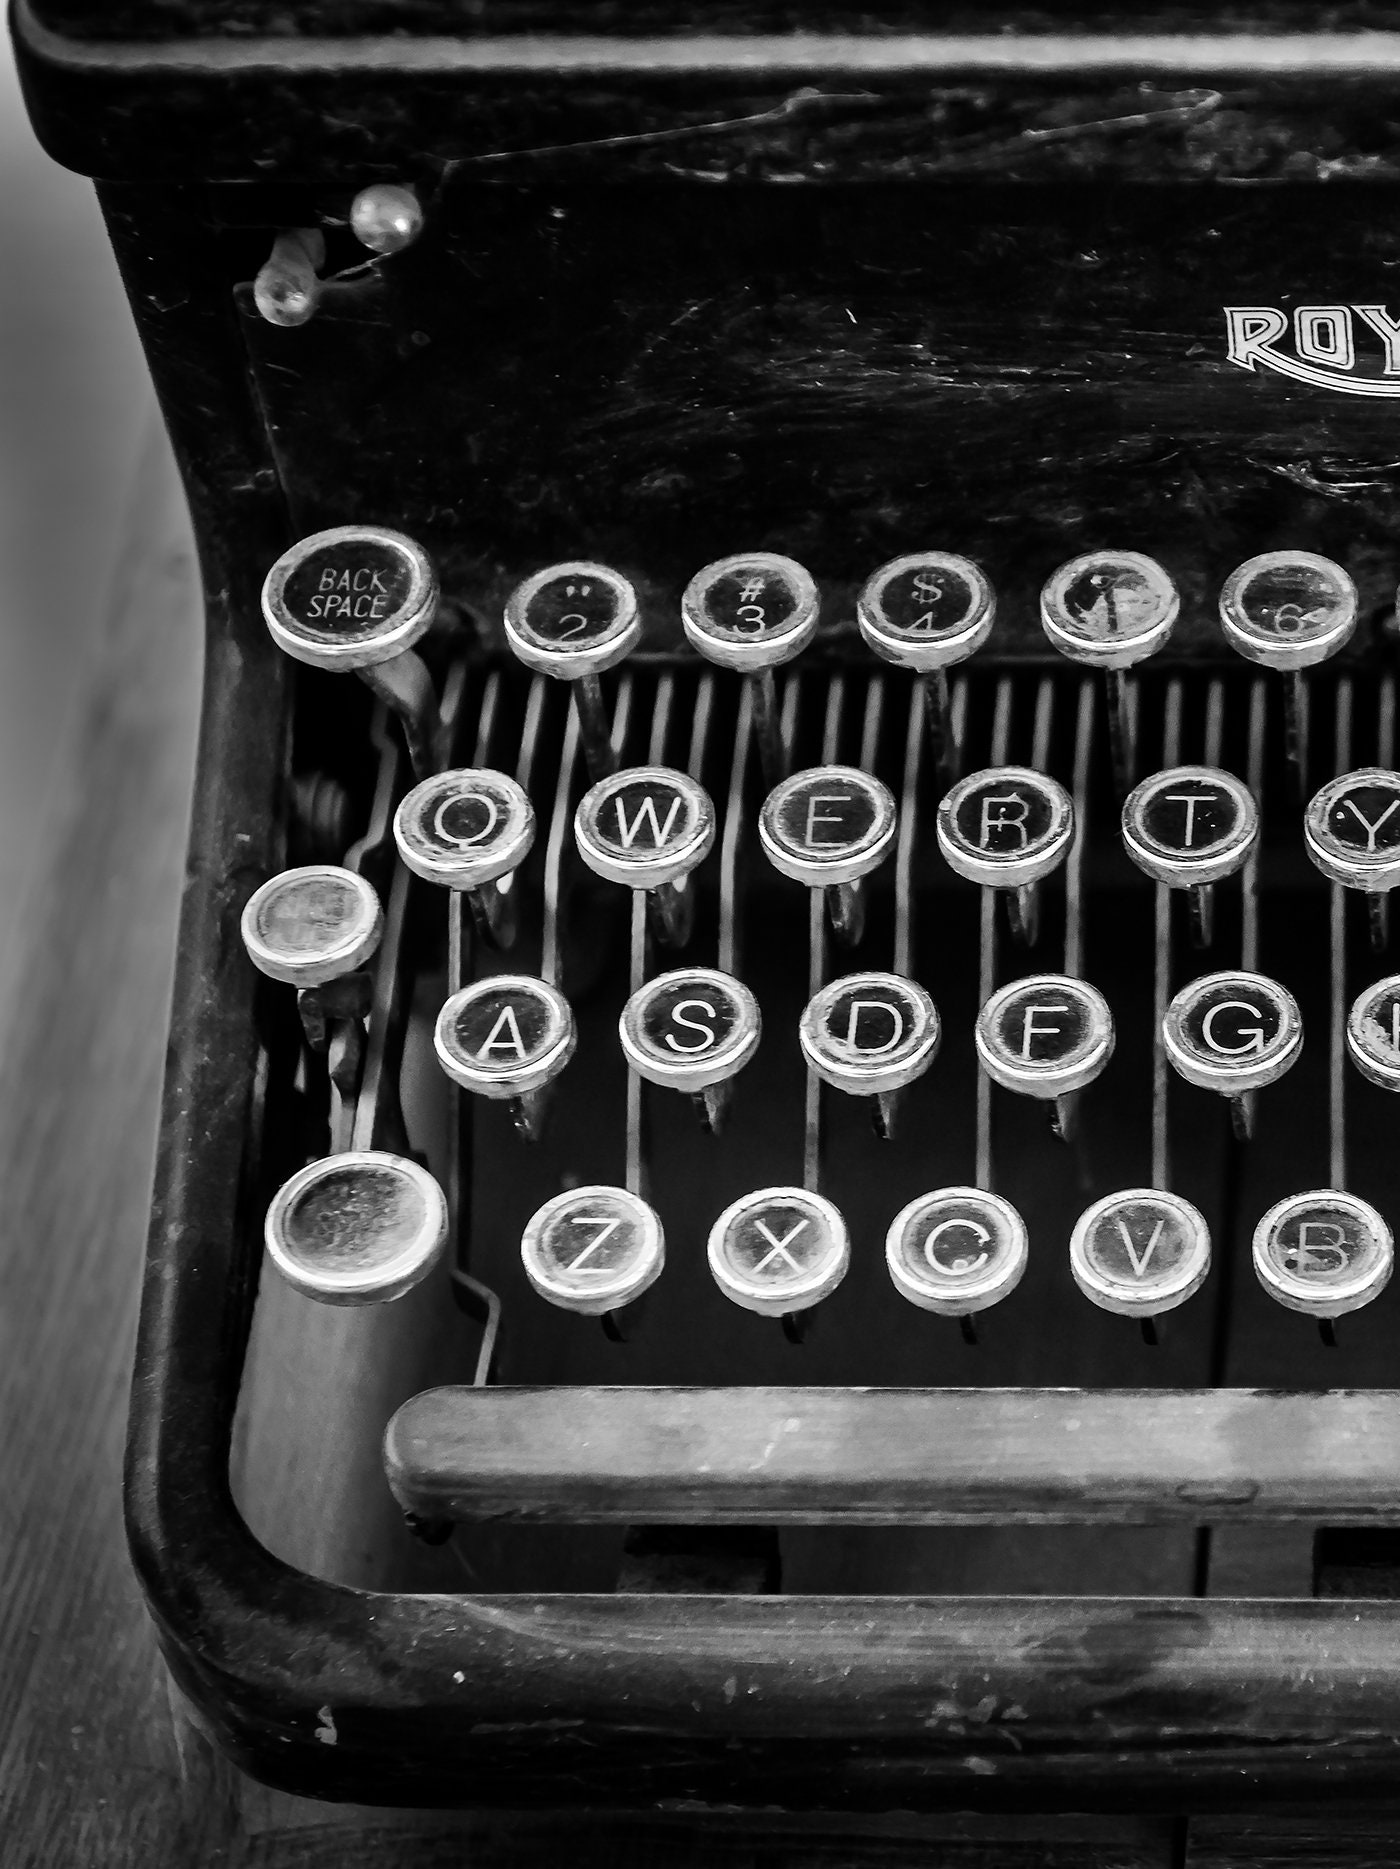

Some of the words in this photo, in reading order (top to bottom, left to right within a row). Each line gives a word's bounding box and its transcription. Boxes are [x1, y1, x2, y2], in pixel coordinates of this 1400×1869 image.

[307, 594, 389, 618] SPACE
[319, 567, 388, 593] BACK
[557, 614, 588, 641] 2
[732, 604, 766, 634] 3
[1273, 603, 1305, 634] 6
[615, 796, 682, 848] W
[805, 795, 852, 847] E
[980, 796, 1030, 848] R
[1165, 796, 1218, 847] T
[1343, 799, 1400, 851] Y
[477, 1006, 526, 1059] A
[664, 999, 717, 1054] S
[846, 1000, 903, 1054] D
[1022, 1006, 1069, 1060] F
[1202, 1001, 1264, 1055] G
[567, 1218, 622, 1274] Z
[753, 1218, 811, 1274] X
[925, 1218, 991, 1276] C
[1118, 1219, 1165, 1276] V
[1299, 1222, 1349, 1276] B
